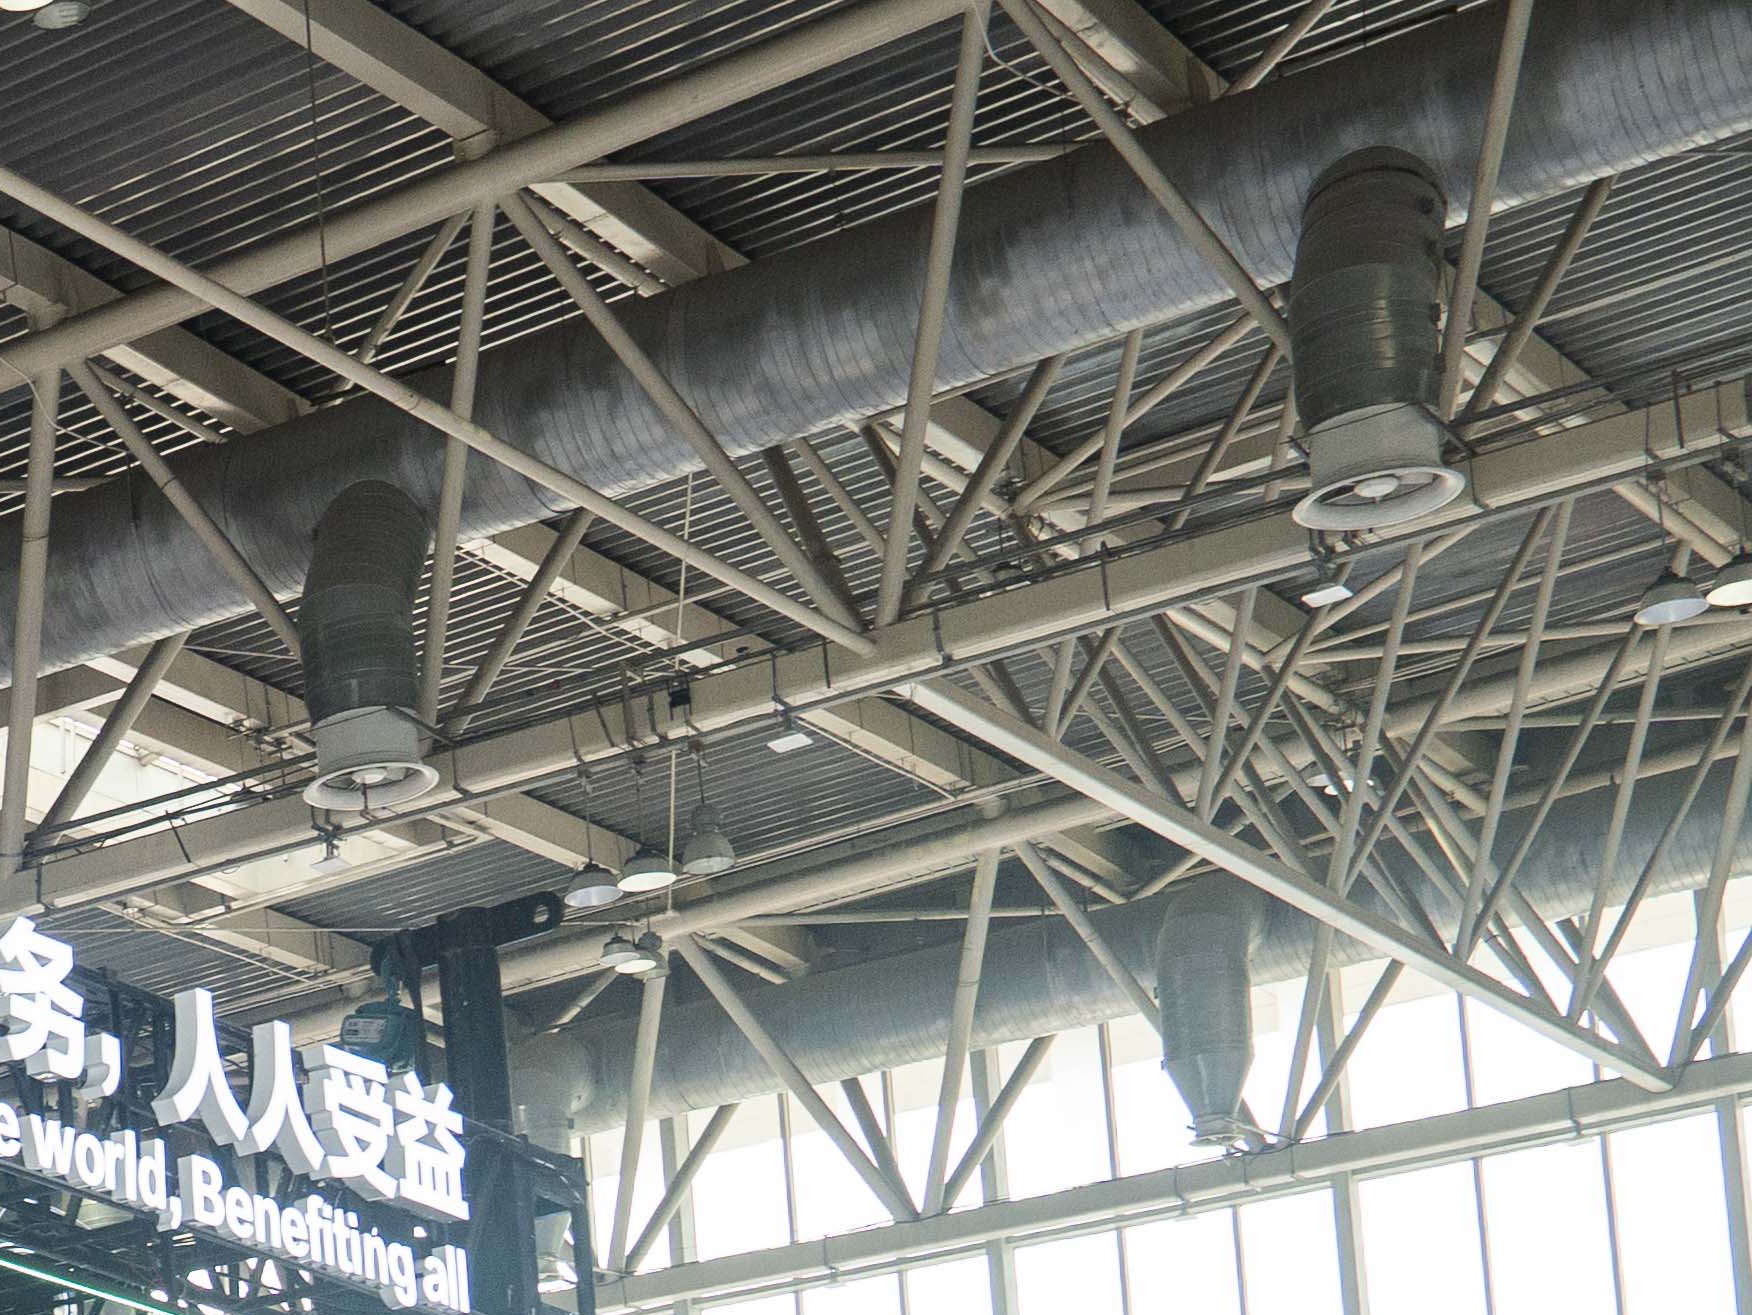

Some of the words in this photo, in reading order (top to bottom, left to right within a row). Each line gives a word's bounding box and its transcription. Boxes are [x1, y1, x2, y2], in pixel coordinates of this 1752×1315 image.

[30, 1113, 182, 1231] world,
[190, 1154, 419, 1307] Benefiting
[424, 1247, 468, 1313] all
